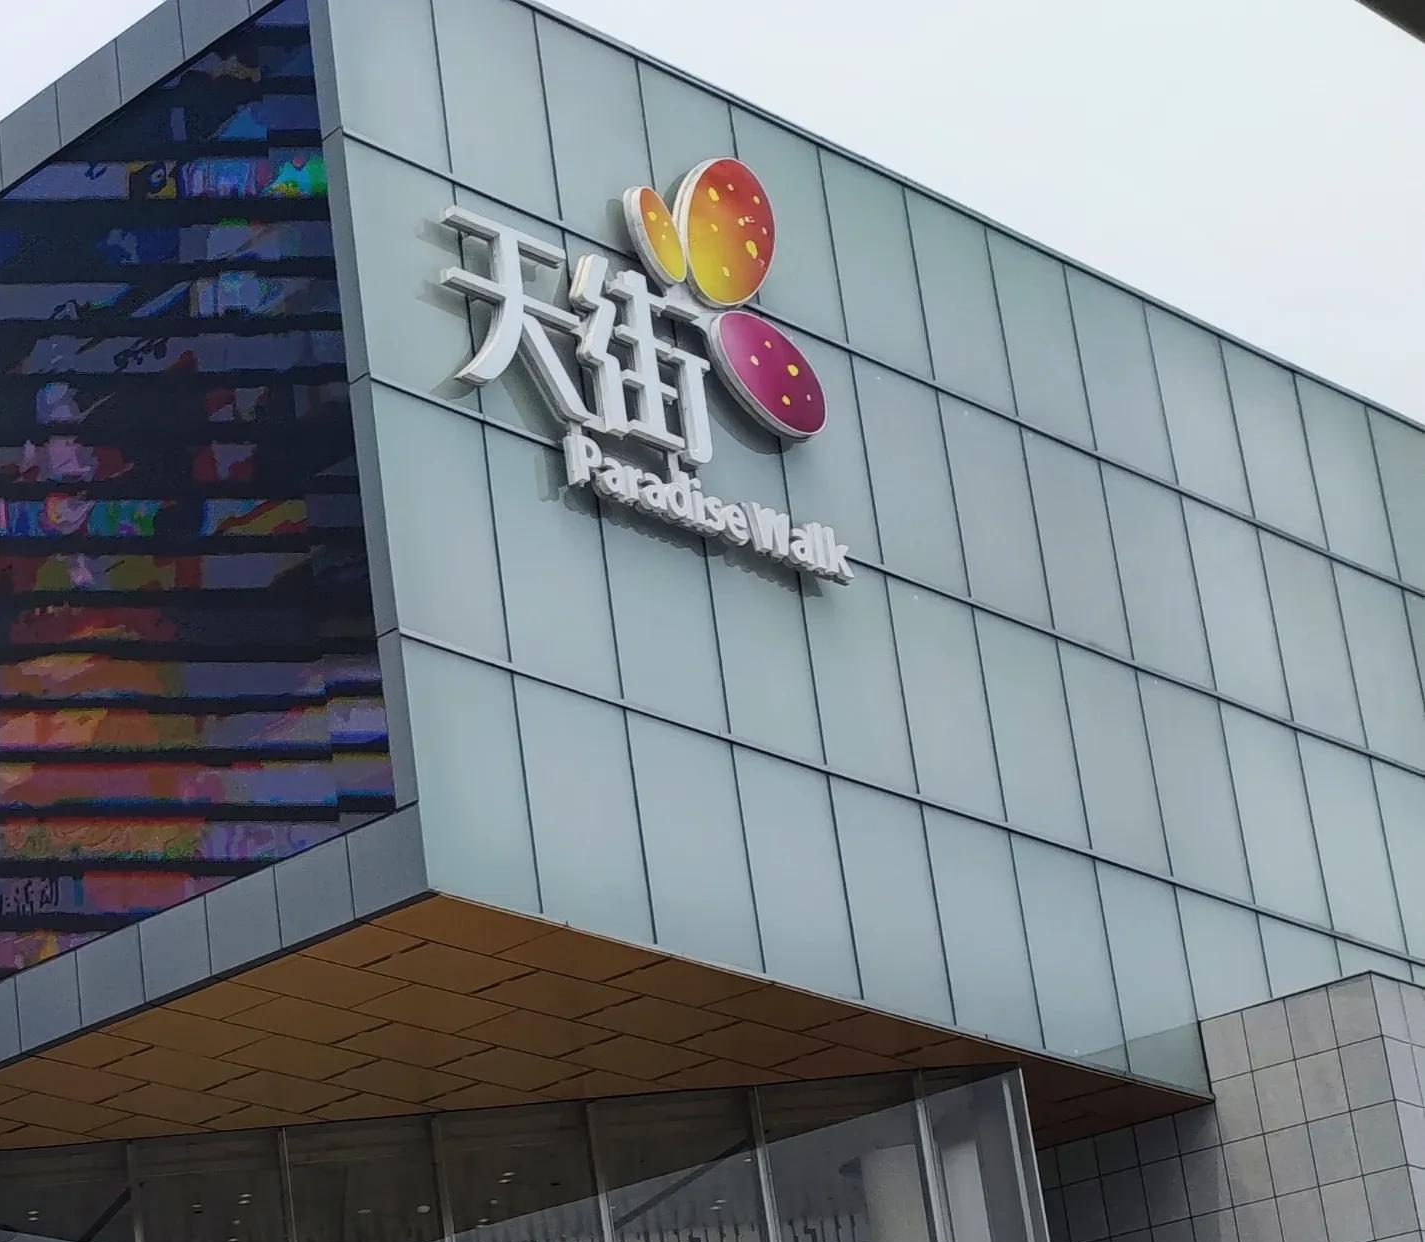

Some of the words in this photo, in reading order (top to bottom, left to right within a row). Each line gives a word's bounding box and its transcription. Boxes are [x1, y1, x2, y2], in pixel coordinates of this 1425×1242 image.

[440, 205, 713, 466] 天街
[563, 433, 751, 547] Paradise
[747, 502, 854, 586] Walk
